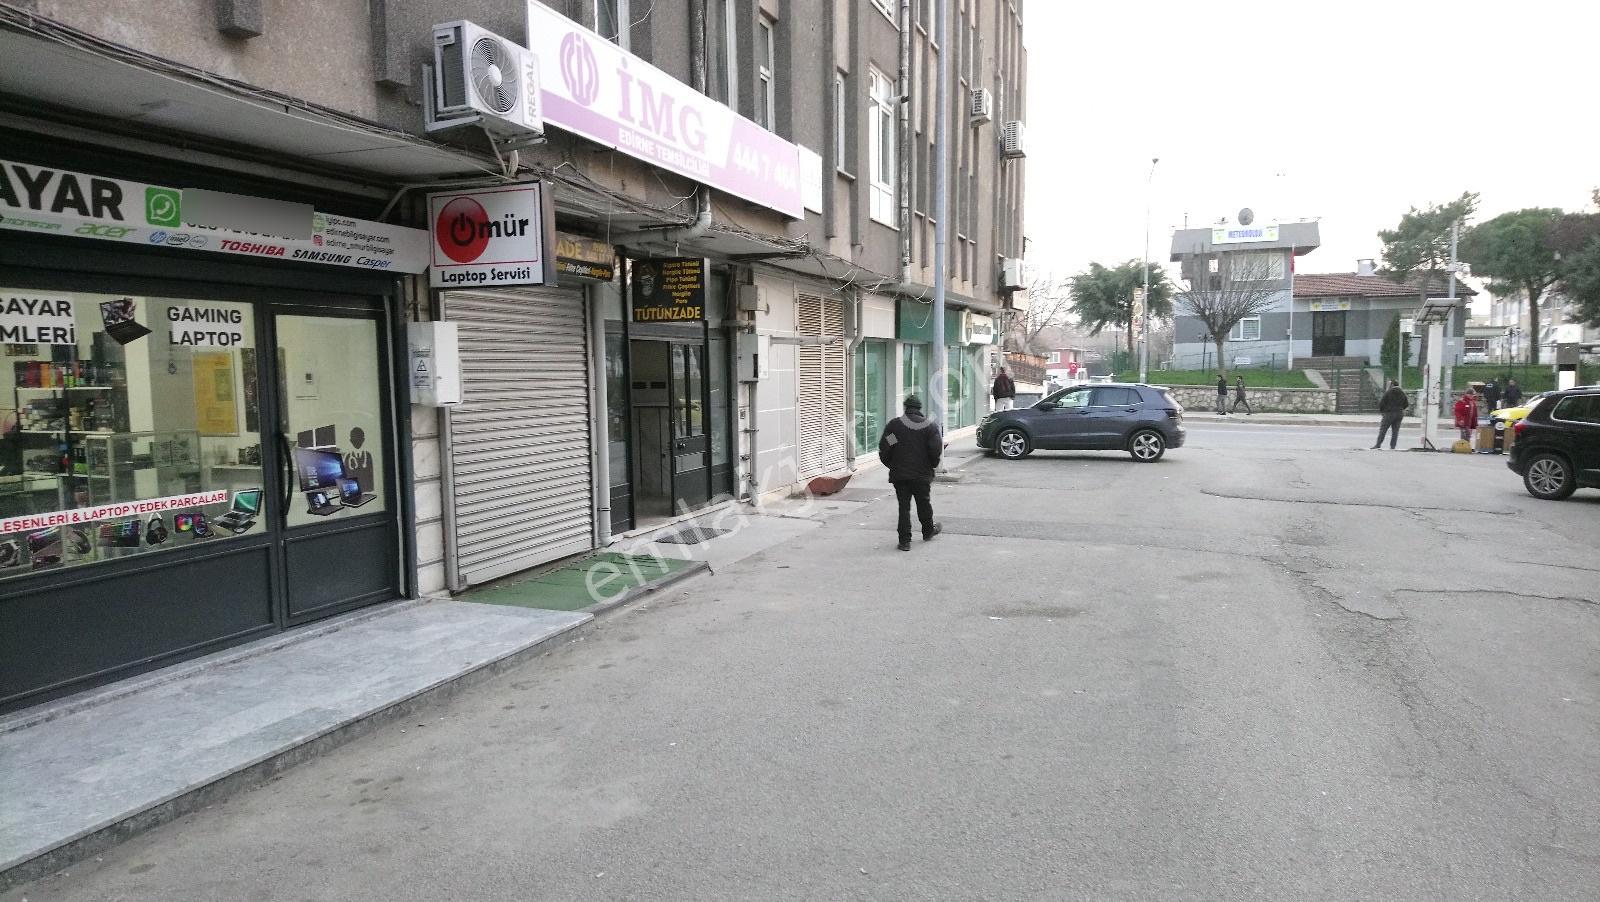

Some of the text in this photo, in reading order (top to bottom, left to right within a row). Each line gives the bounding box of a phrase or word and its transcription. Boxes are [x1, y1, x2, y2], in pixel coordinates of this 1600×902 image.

[525, 60, 537, 118] REGAL
[75, 222, 137, 239] acer
[220, 239, 286, 257] TOSHIBA
[292, 249, 352, 265] SAMSUNG
[356, 256, 392, 269] Casper
[441, 266, 531, 284] Laptop Servisi
[167, 305, 242, 324] GAMING
[635, 304, 701, 320] TÜTÜNZADE
[168, 330, 242, 346] LAPTOP
[0, 512, 69, 533] EŞENLERİ
[72, 512, 79, 522] &
[83, 505, 130, 520] LAPTOP
[132, 501, 168, 513] YEDEK
